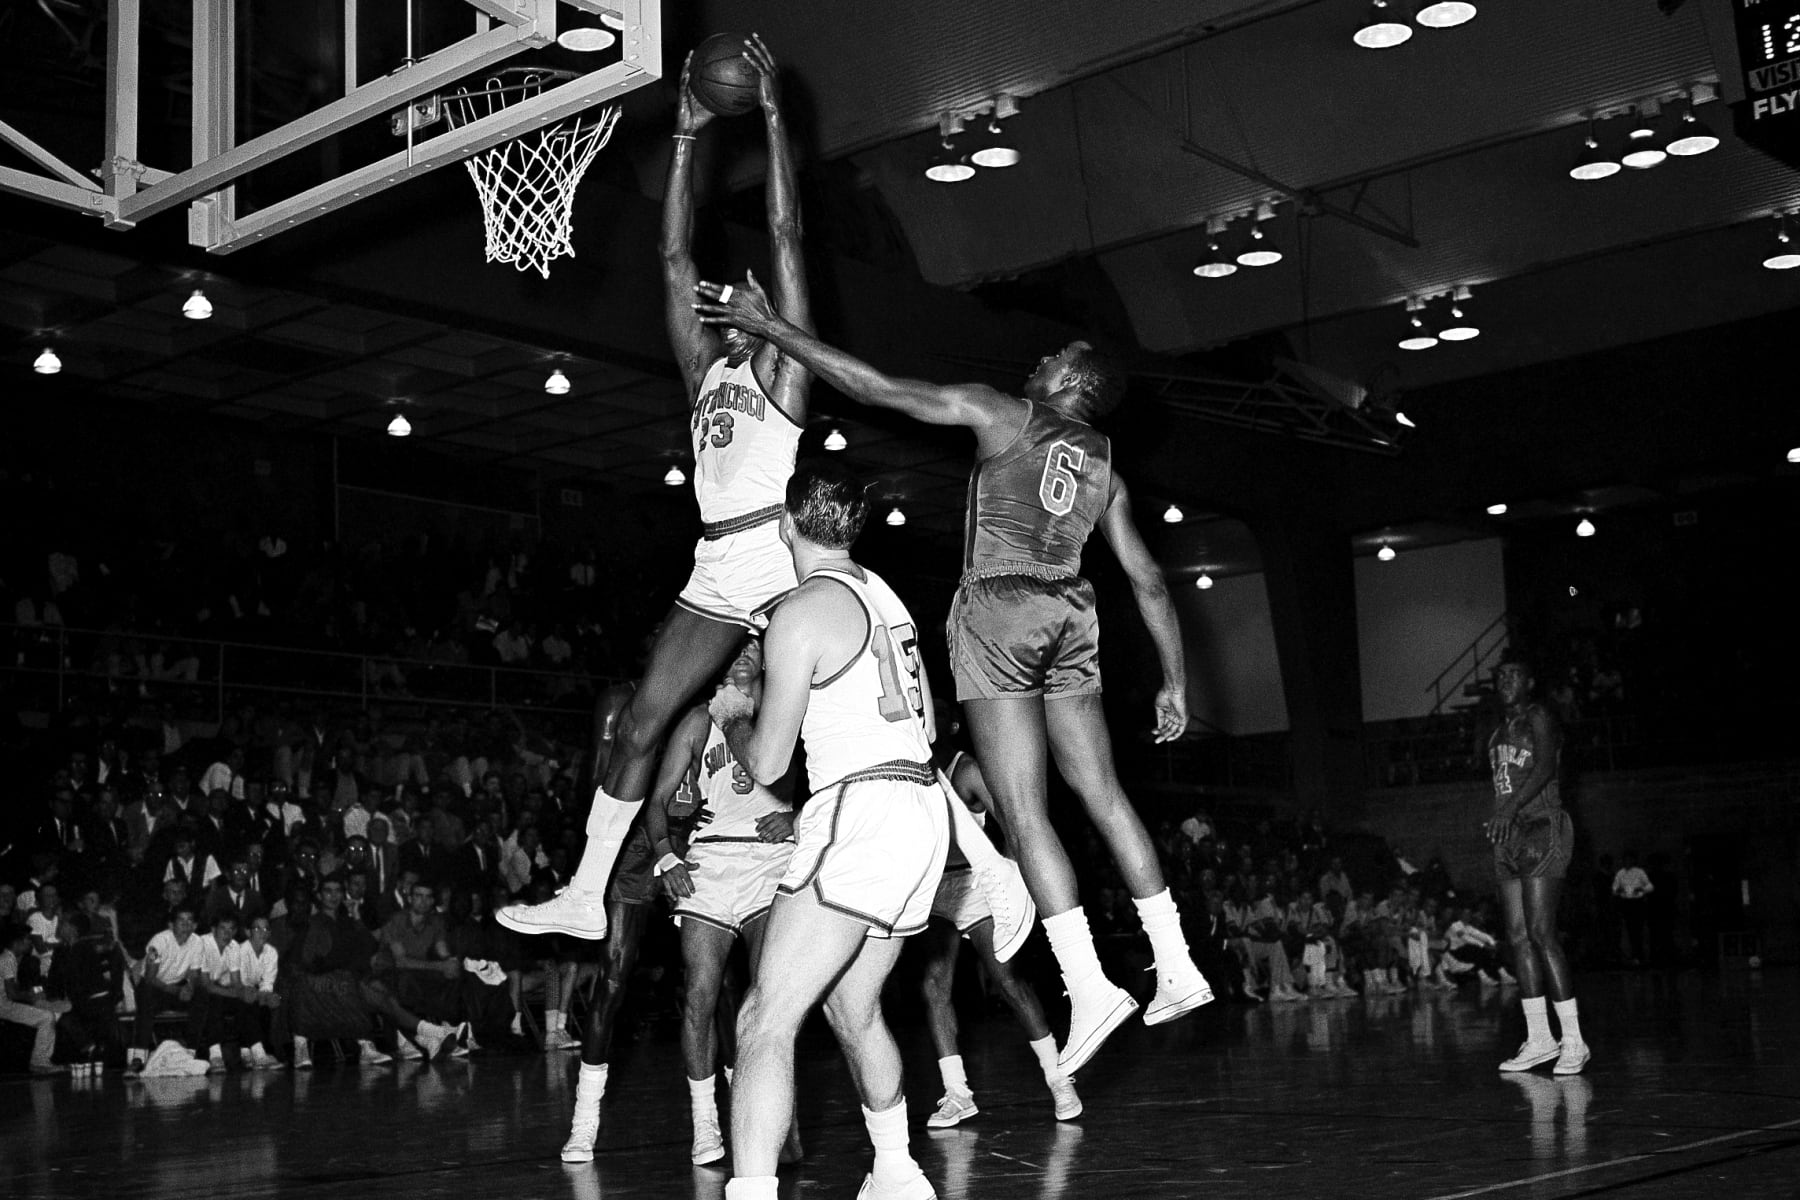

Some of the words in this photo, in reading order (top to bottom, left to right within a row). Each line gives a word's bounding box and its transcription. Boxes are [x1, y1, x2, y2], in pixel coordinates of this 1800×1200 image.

[1756, 60, 1800, 88] VISI
[1753, 89, 1800, 120] FLY
[1039, 440, 1084, 516] 6
[871, 622, 925, 724] 15
